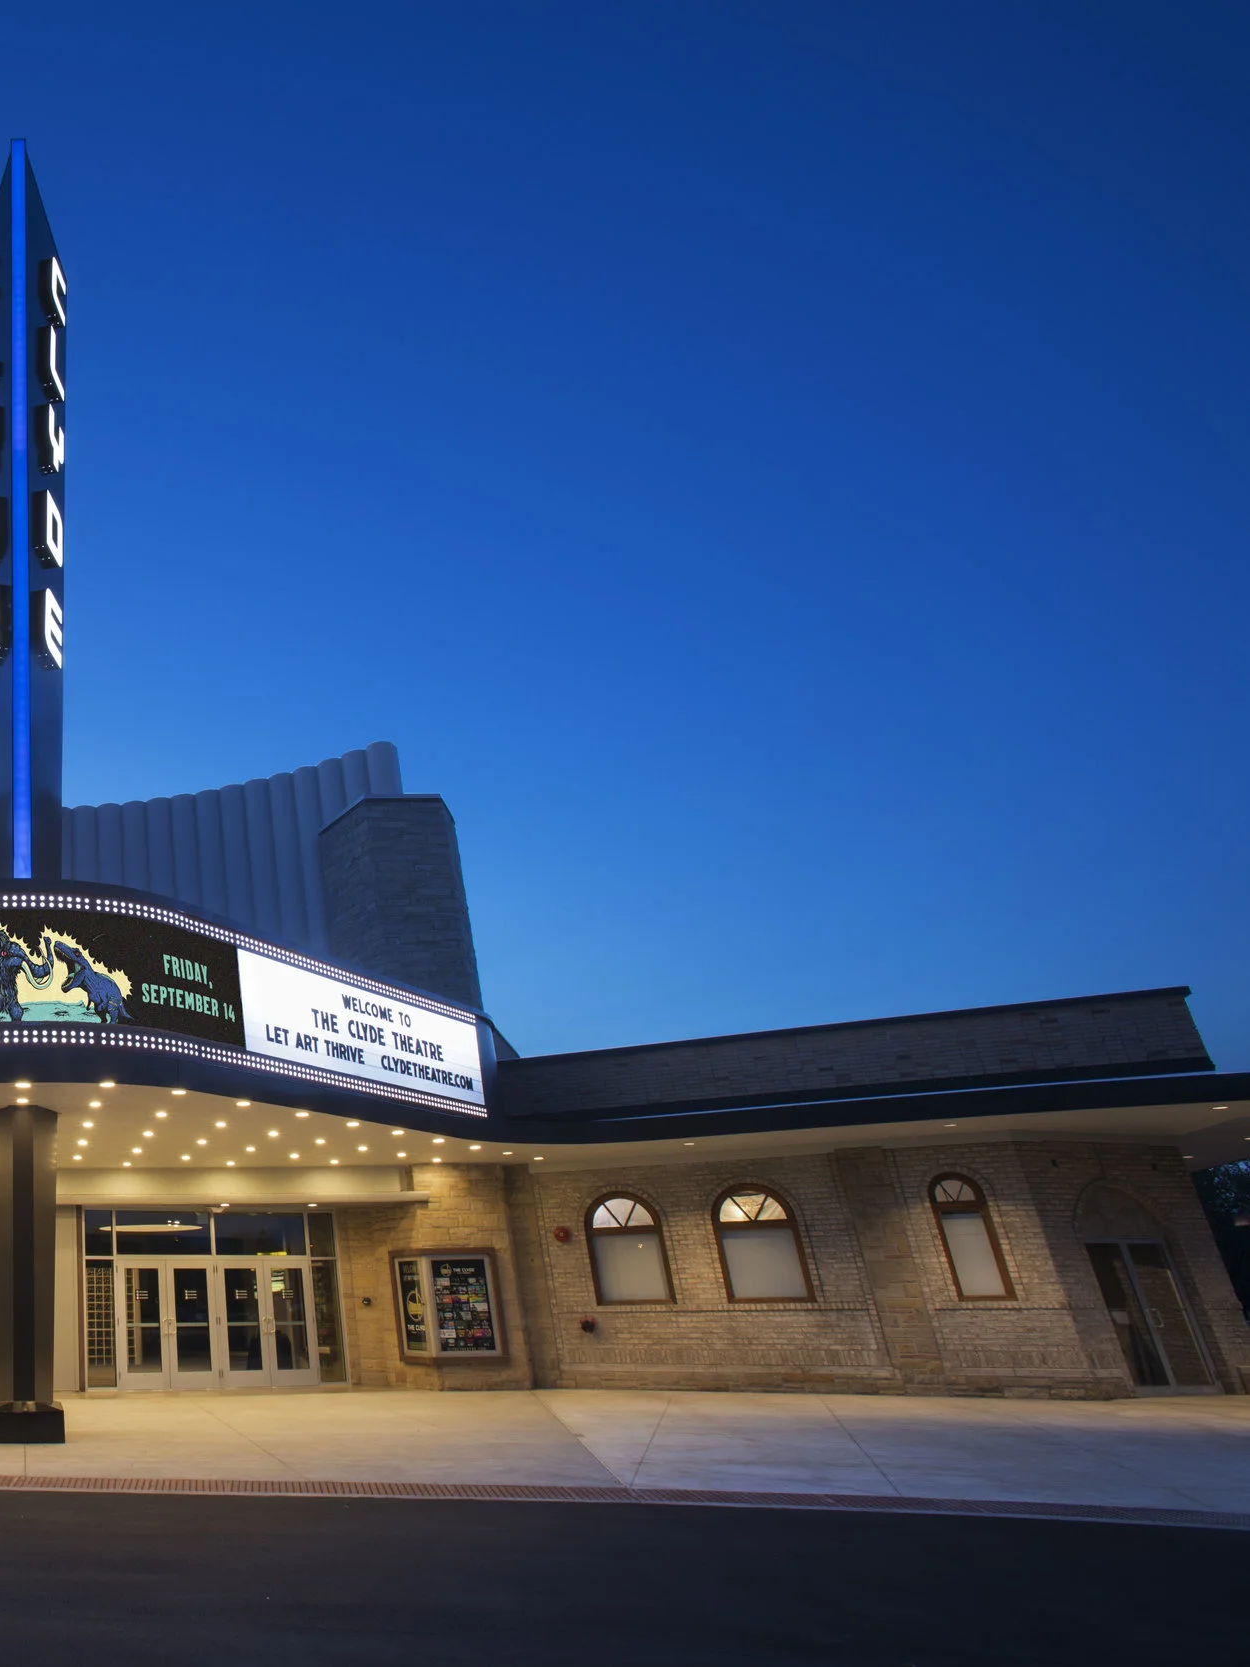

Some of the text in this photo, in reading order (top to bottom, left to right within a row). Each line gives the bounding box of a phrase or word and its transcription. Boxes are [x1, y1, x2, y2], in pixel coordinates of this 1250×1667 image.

[44, 256, 67, 670] CLYDE
[162, 954, 213, 990] FRIDAY,
[141, 982, 236, 1023] SEPTEMBER 14
[341, 994, 412, 1028] WELCOME TO
[265, 1023, 474, 1092] LET ART THRIVE CLYDETHEATRE.COM
[310, 1007, 444, 1062] THE CLYDE THEATRE
